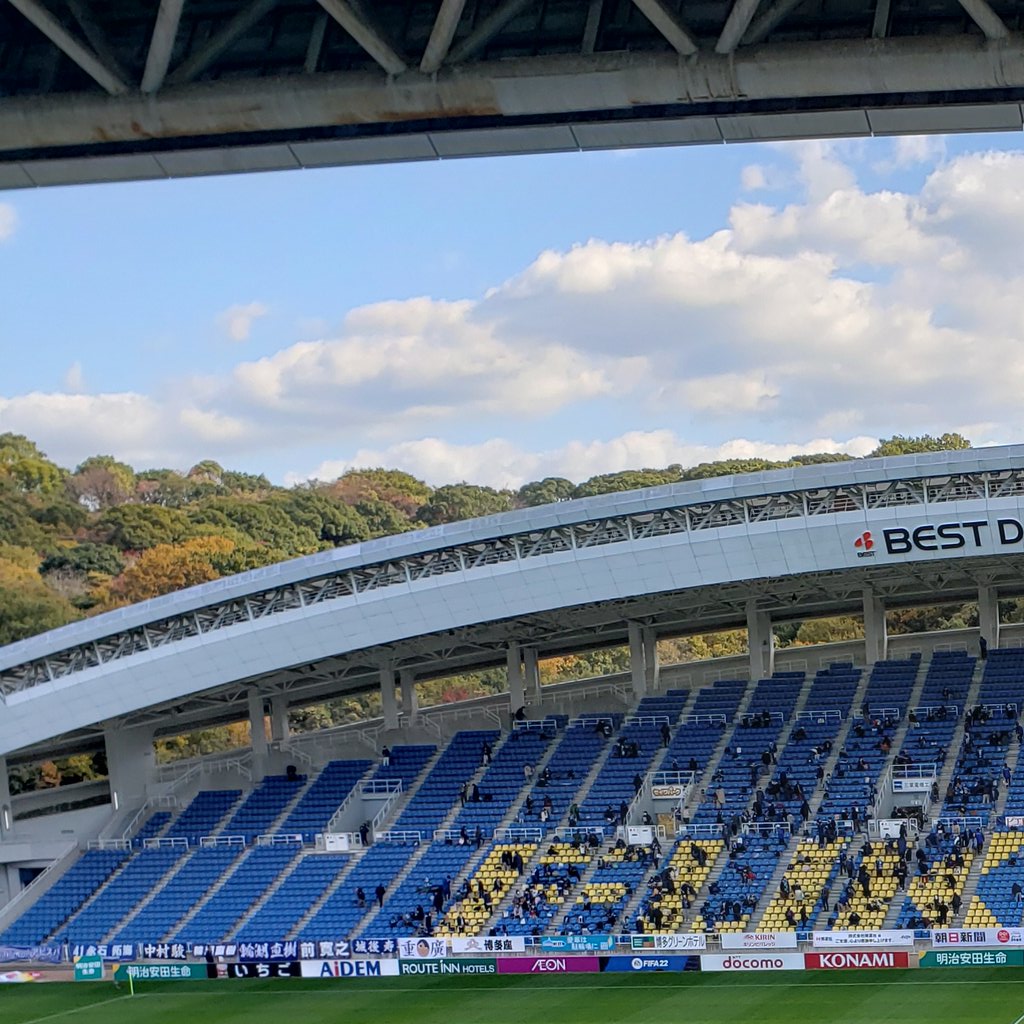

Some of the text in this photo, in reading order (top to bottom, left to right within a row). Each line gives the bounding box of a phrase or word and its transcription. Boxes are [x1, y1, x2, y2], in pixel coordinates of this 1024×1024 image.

[883, 520, 987, 554] BEST
[656, 935, 705, 948] 博多グリーンホテル
[935, 932, 986, 943] 朝日新聞
[144, 943, 170, 958] 中村
[301, 943, 315, 957] 前
[402, 940, 416, 957] 重
[484, 939, 513, 951] 博多座
[723, 956, 783, 968] docomo
[819, 953, 895, 968] KONAMI
[936, 952, 1007, 965] 明治安田生命
[126, 966, 191, 978] 明治安田生命
[234, 962, 291, 977] いちご
[402, 963, 439, 974] ROUTE
[463, 963, 495, 973] HOTELS
